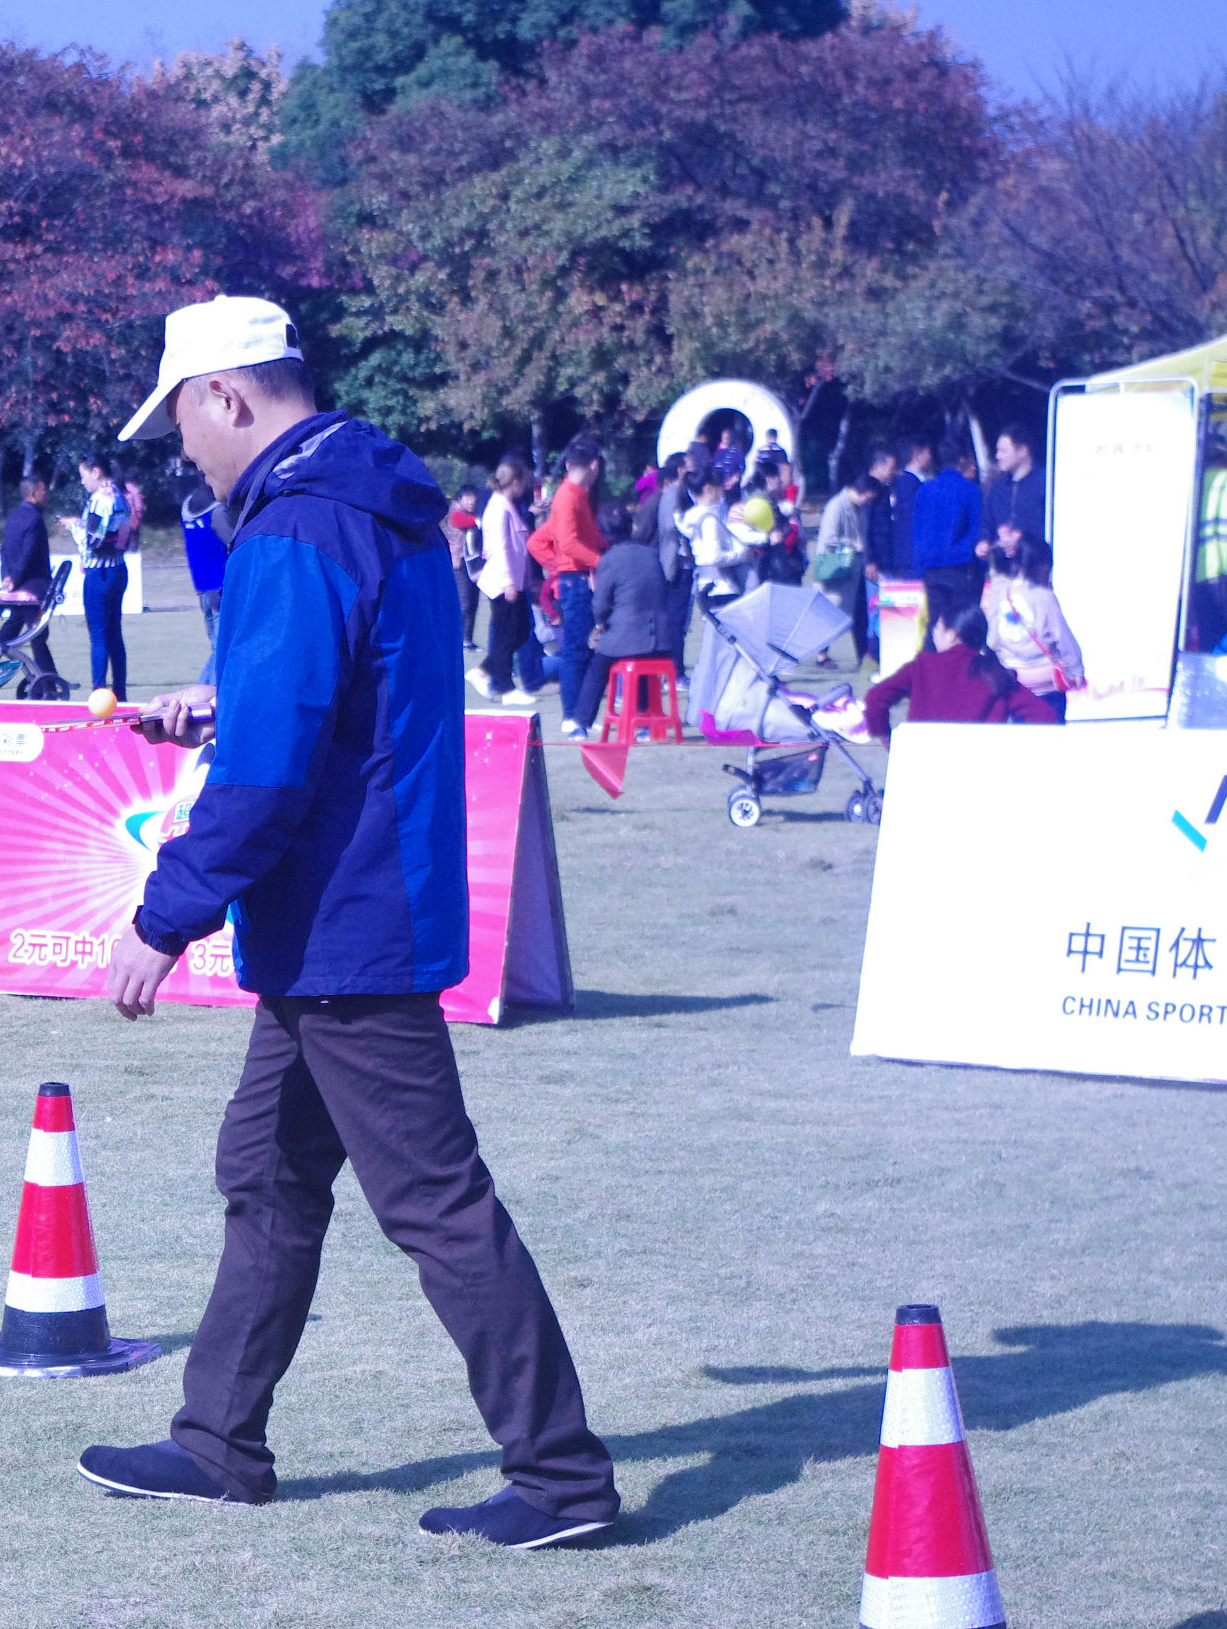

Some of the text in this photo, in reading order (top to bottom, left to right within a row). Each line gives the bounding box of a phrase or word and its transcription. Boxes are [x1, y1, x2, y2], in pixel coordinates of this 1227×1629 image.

[1066, 922, 1216, 979] 中国体
[1062, 995, 1137, 1020] CHINA
